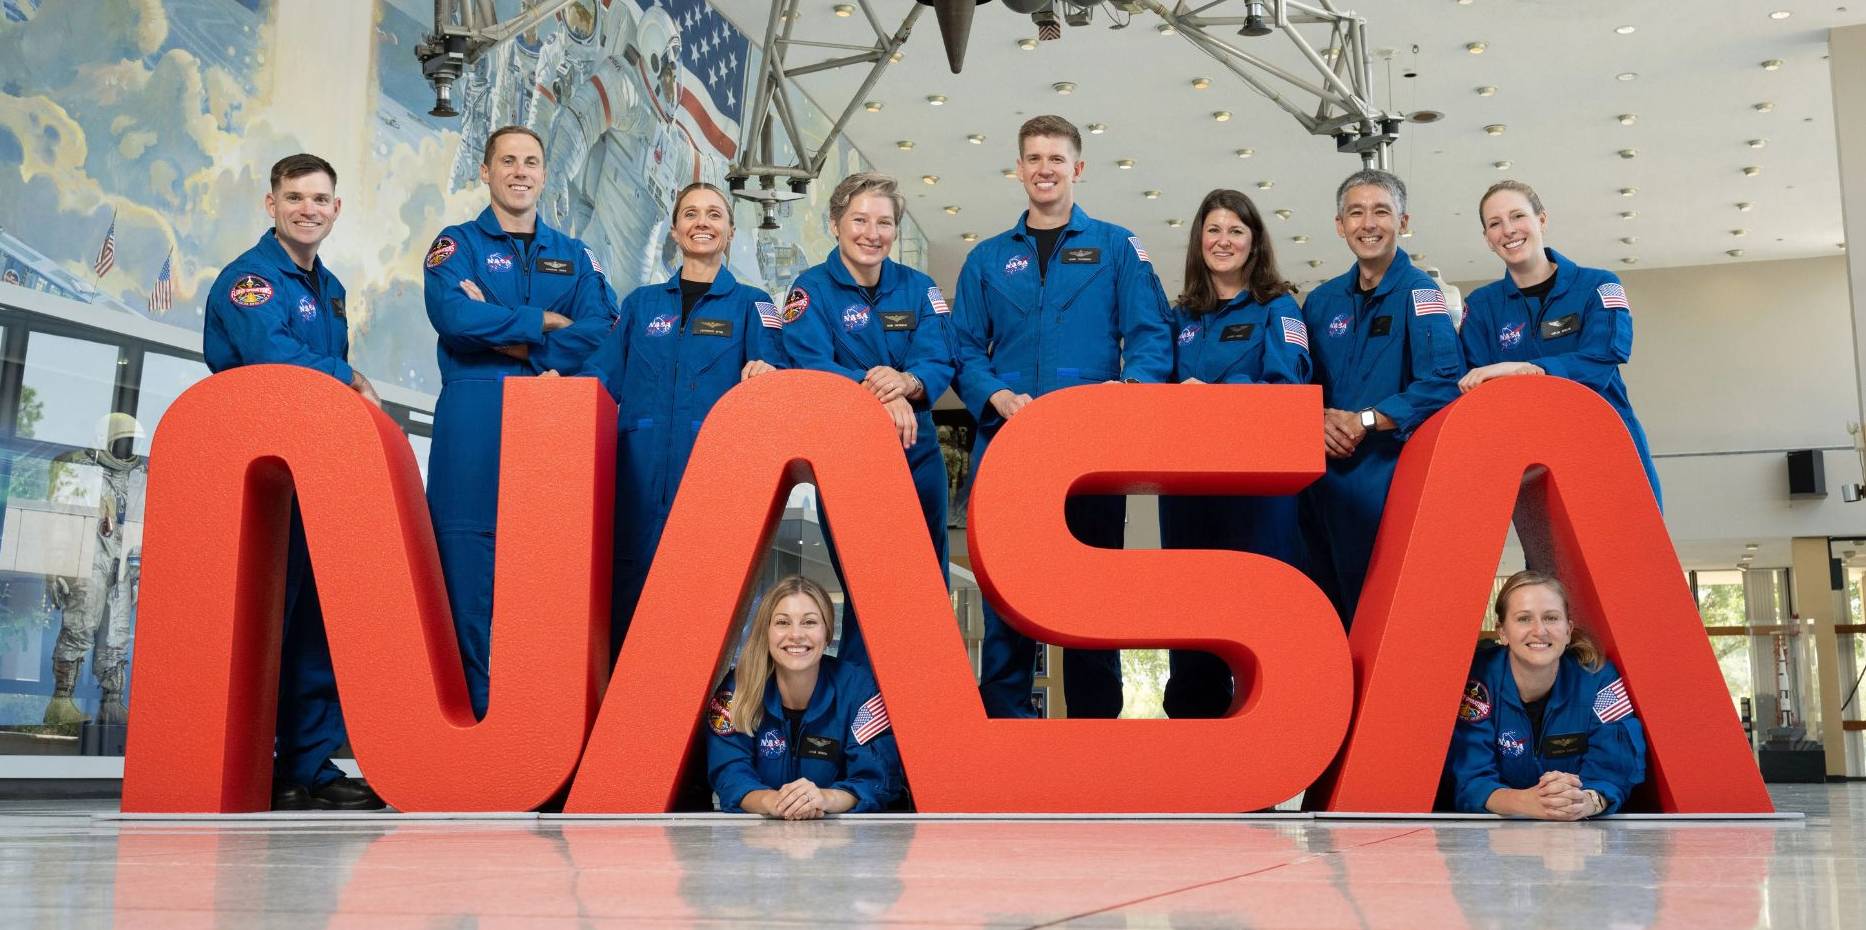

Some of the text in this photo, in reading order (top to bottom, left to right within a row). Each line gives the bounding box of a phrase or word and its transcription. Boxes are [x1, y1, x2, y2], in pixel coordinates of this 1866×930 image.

[487, 257, 512, 267] NASA
[1005, 259, 1028, 270] NASA
[299, 303, 316, 313] NASA
[843, 312, 869, 321] NASA
[648, 321, 671, 329] NASA
[1499, 331, 1521, 340] NASA
[122, 364, 1775, 814] NASA
[760, 738, 786, 748] NASA
[1498, 737, 1524, 751] NASA
